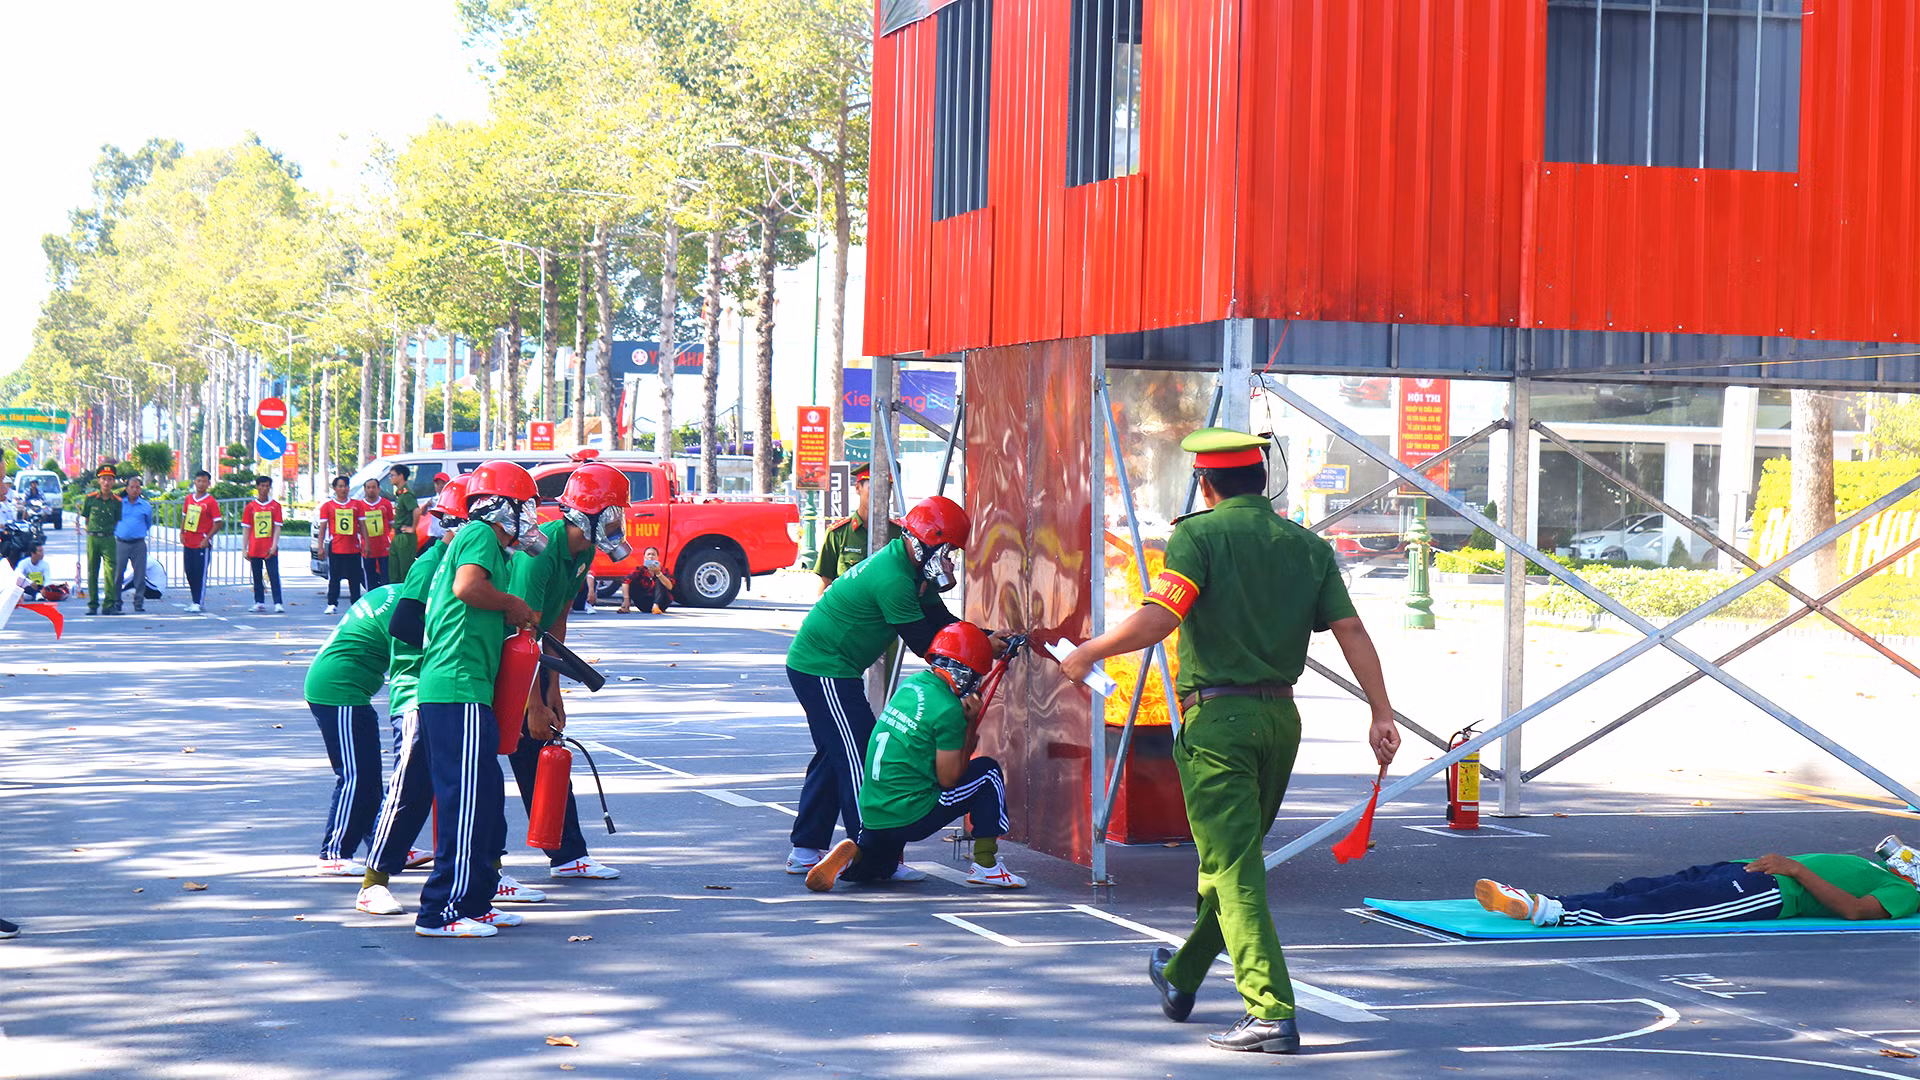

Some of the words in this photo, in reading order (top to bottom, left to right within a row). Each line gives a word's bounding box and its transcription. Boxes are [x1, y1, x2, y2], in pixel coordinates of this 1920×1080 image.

[648, 349, 704, 367] YAHA
[1407, 393, 1423, 403] HỘI
[1425, 394, 1441, 403] THI
[258, 521, 268, 535] 2
[340, 518, 349, 531] 6
[372, 519, 378, 533] 1
[636, 523, 660, 536] HUY
[1166, 583, 1187, 604] TÀI
[871, 731, 890, 782] 1
